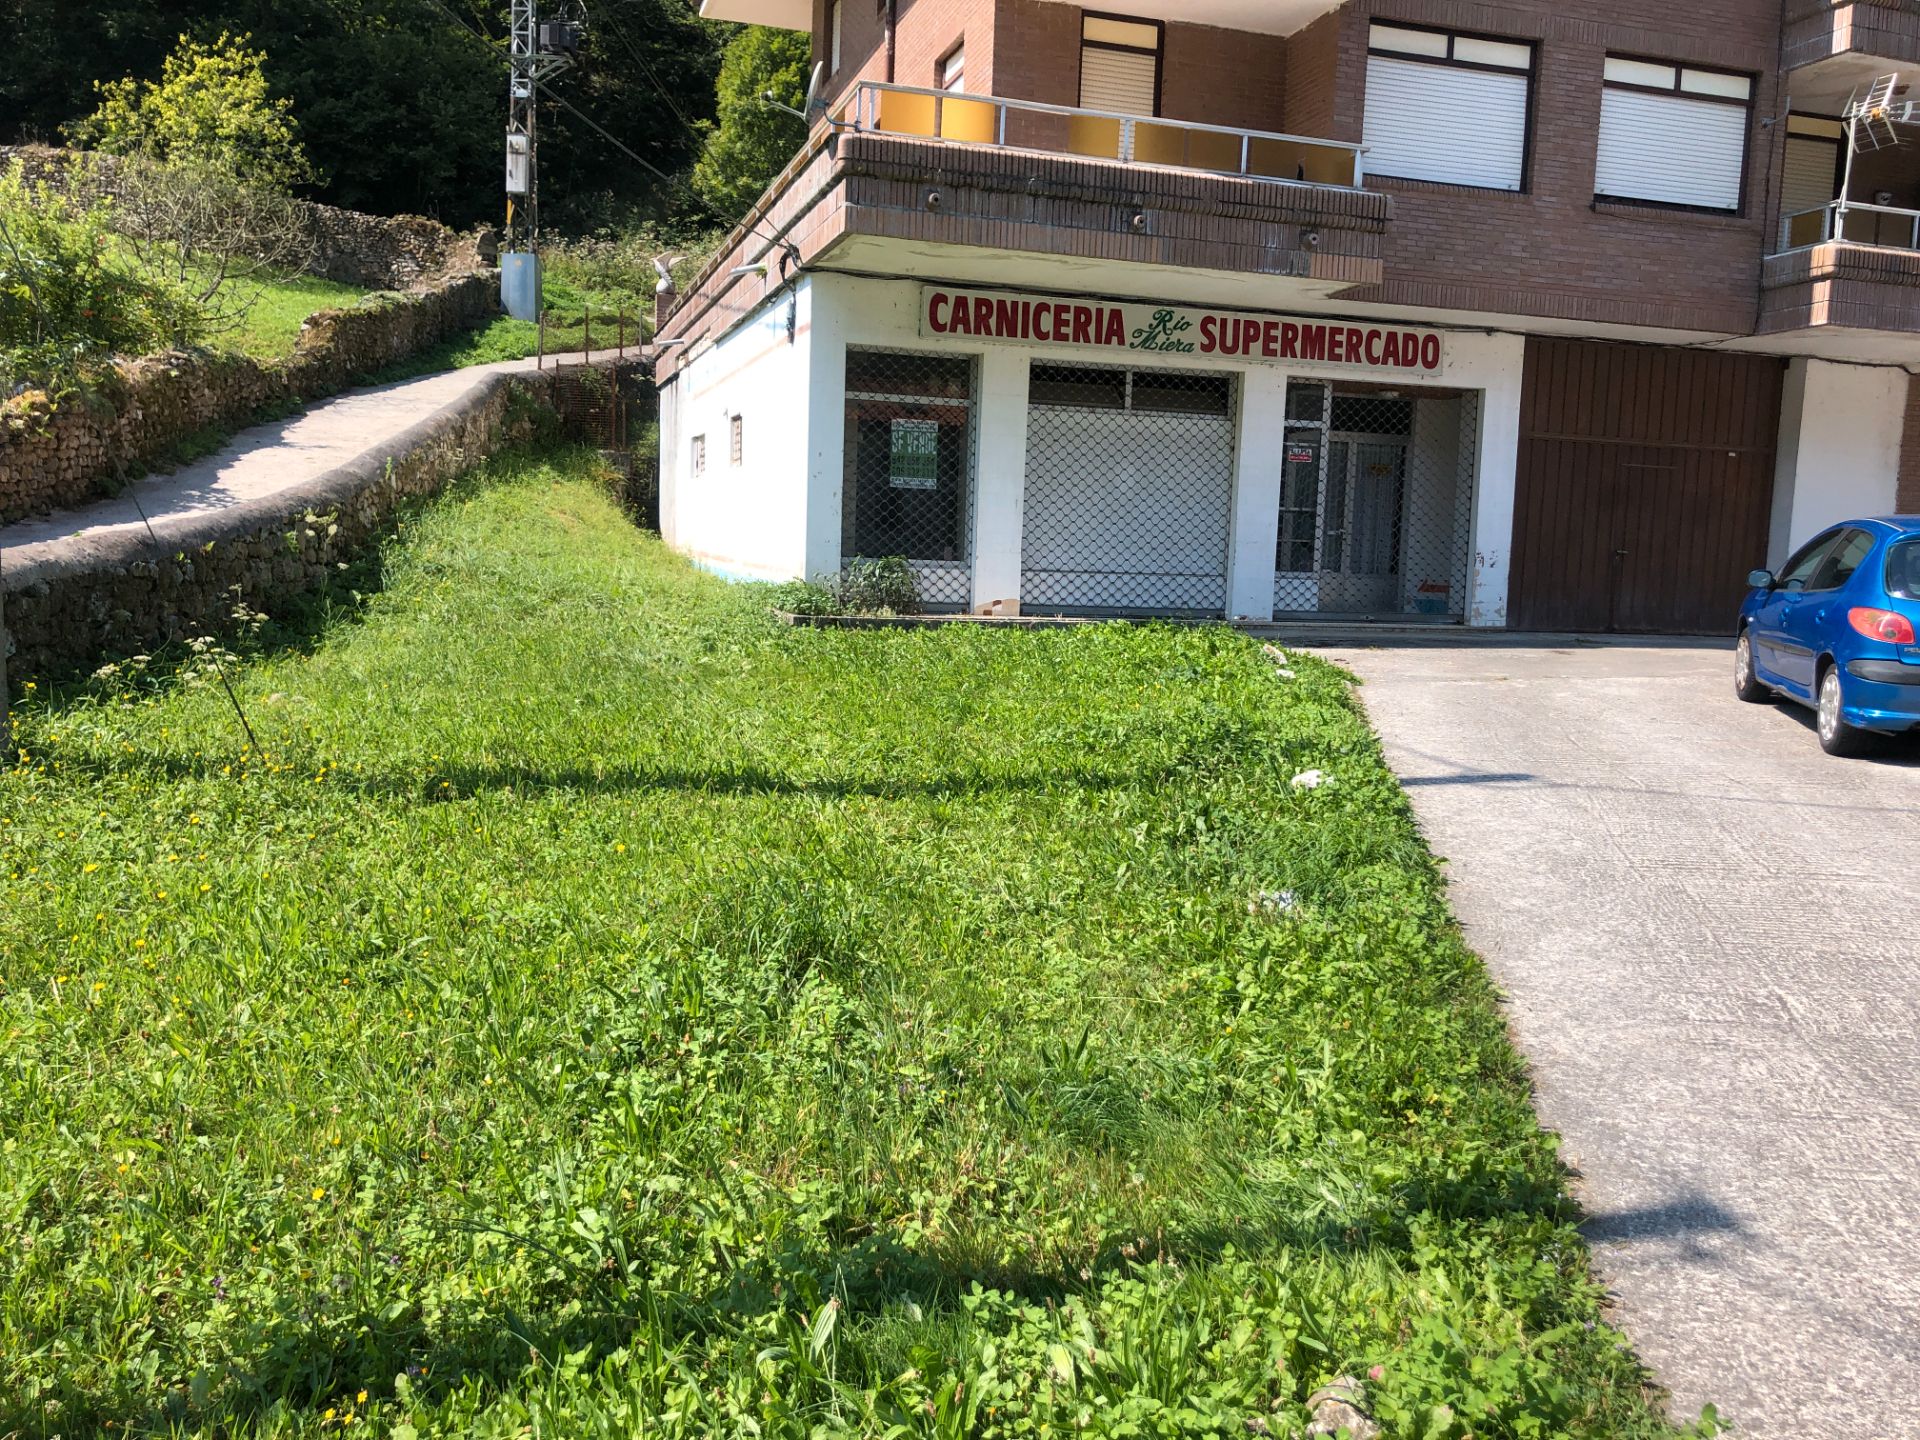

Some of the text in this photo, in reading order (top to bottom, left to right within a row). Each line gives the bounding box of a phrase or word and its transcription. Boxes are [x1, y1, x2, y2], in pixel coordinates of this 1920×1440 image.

[928, 292, 1126, 347] CARNICERIA
[1129, 328, 1195, 353] Miera
[1199, 315, 1440, 370] SUPERMERCADO
[892, 431, 937, 455] SE VENDE
